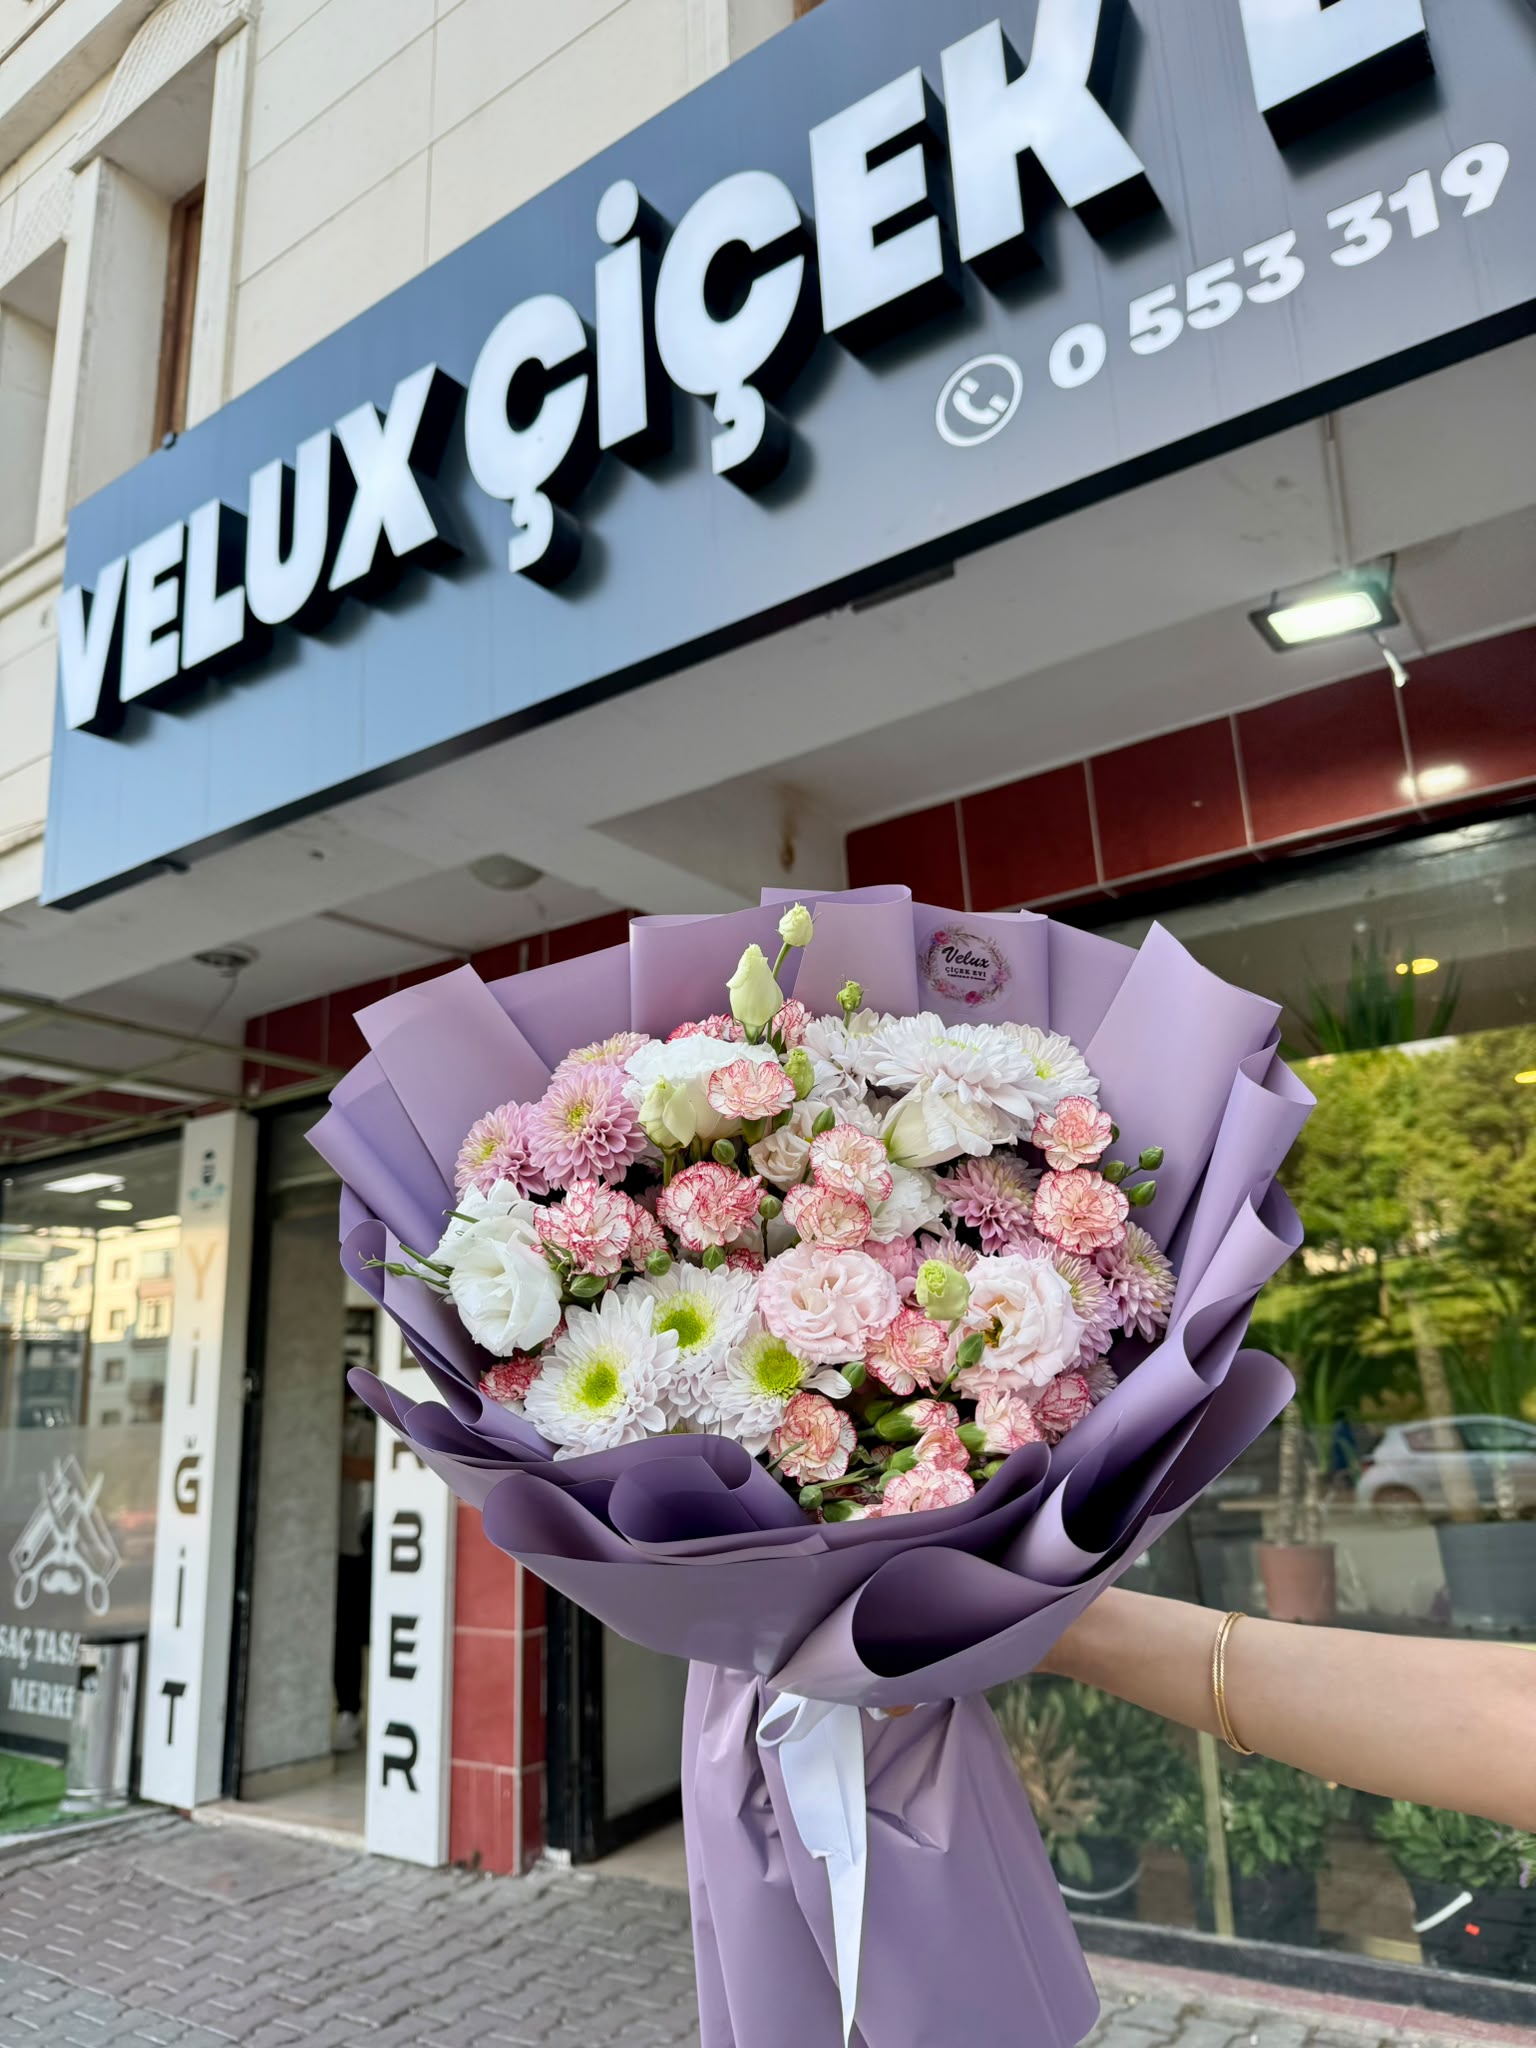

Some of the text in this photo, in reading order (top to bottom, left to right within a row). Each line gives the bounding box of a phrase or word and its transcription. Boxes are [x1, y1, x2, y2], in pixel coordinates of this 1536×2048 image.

[1049, 141, 1510, 389] 0 553 319
[56, 0, 1145, 731] VELUX ÇİÇEK
[941, 946, 990, 968] Velux
[0, 1624, 32, 1670] SAÇ
